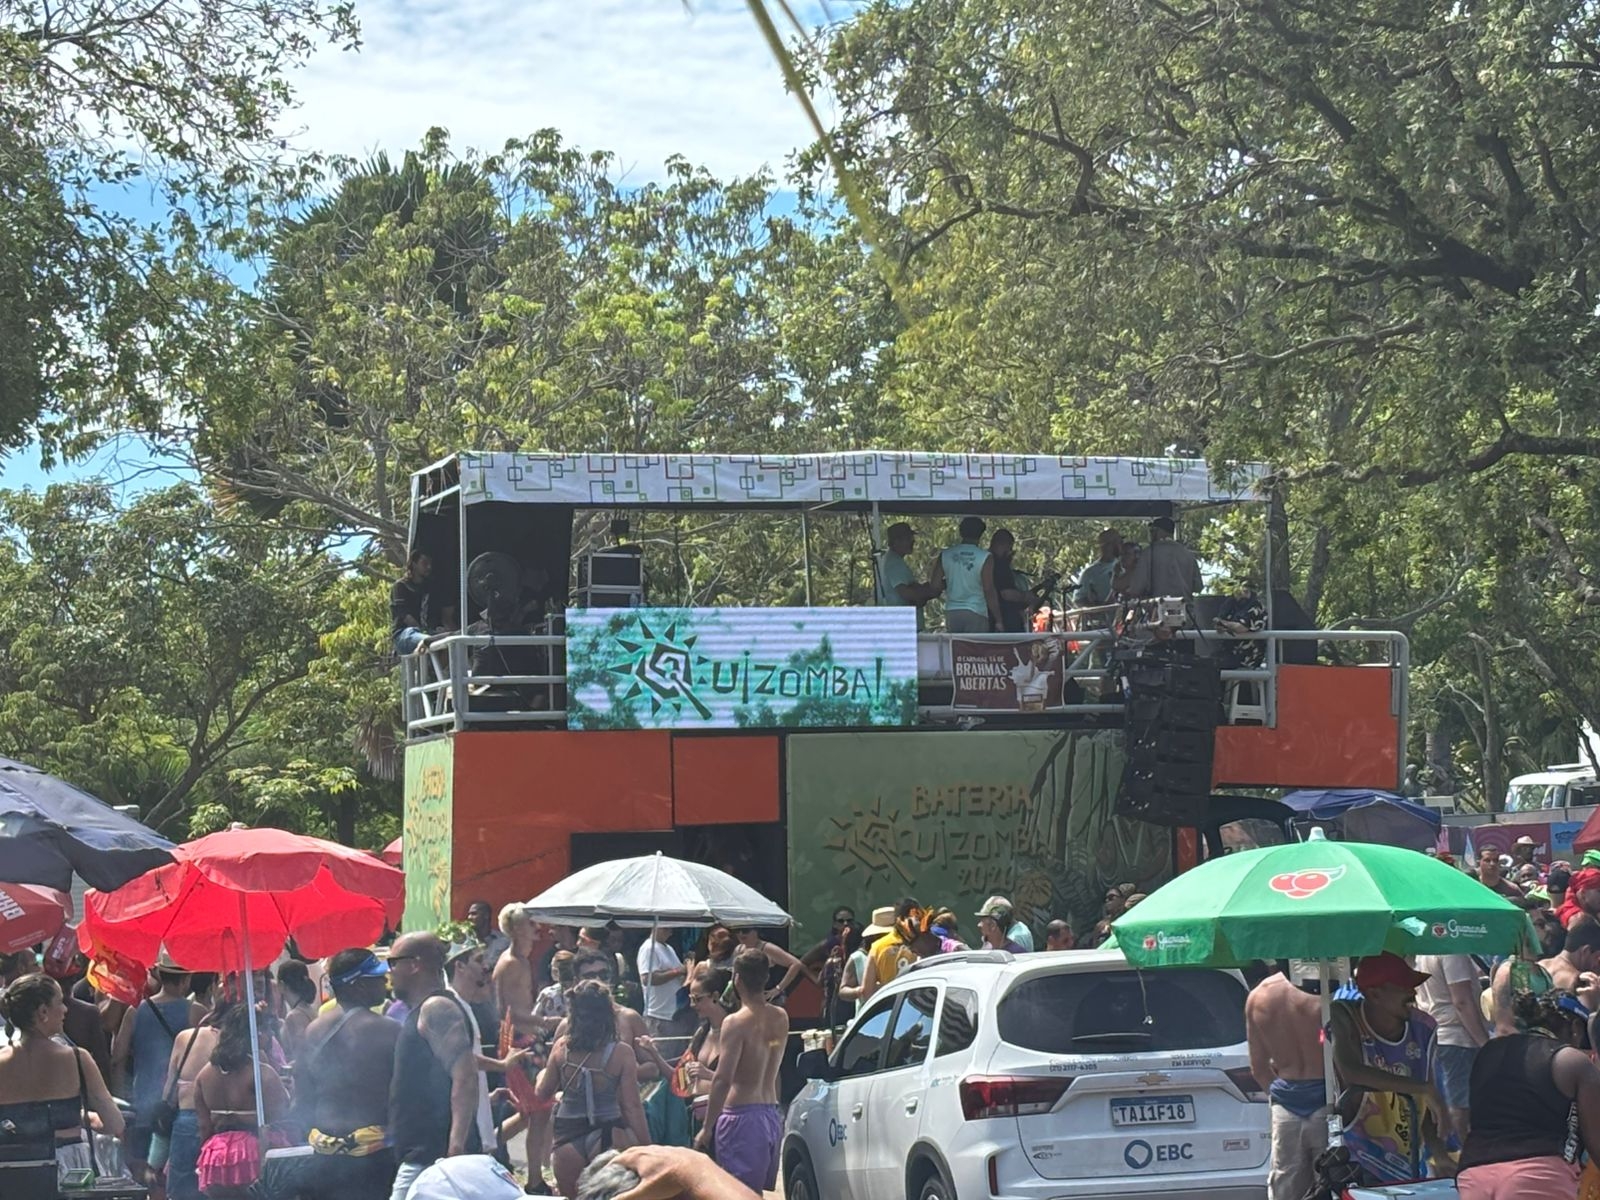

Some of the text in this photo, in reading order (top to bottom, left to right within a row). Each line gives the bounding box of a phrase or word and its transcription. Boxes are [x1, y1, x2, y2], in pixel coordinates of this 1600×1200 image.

[956, 662, 1008, 676] BRAHMAS
[959, 676, 1007, 690] ABERTAS
[911, 783, 1034, 820] BATERIA
[1118, 1104, 1186, 1122] TAI1F18
[1156, 1143, 1194, 1161] EBC
